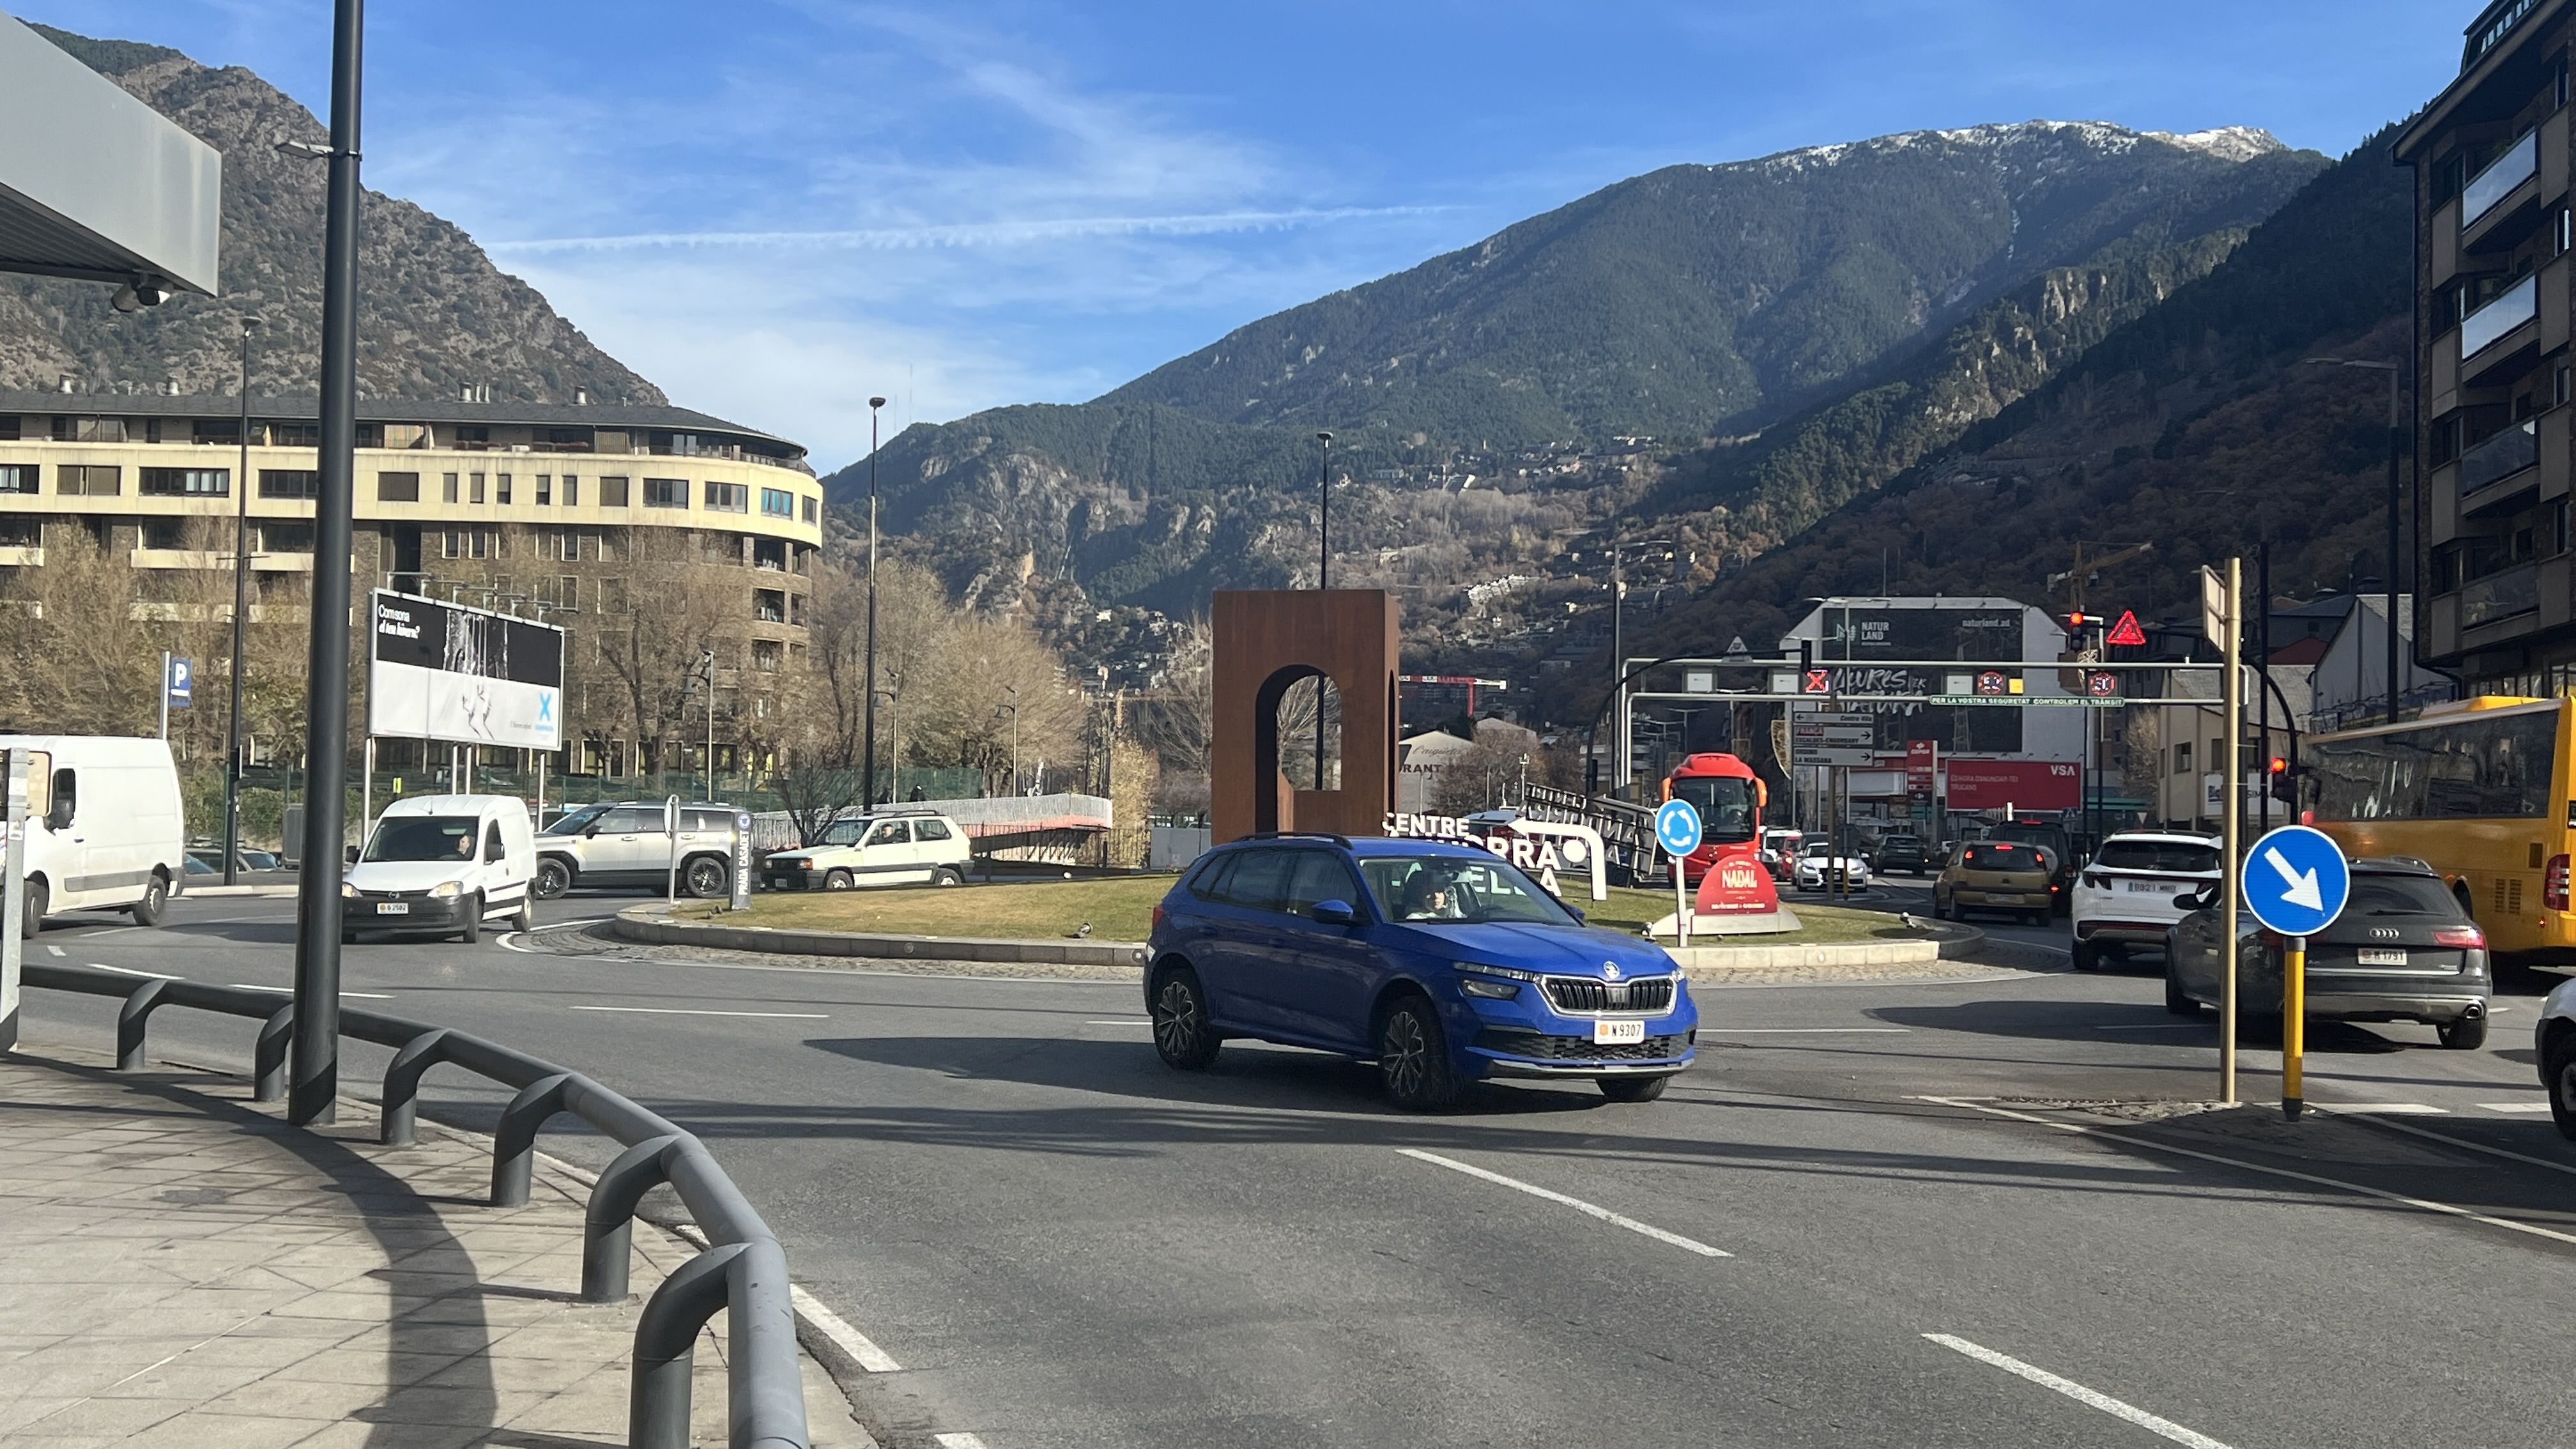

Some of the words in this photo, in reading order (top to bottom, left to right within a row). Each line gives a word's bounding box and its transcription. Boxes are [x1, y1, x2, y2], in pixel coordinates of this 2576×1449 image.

[1861, 622, 1889, 631] NATUR
[1861, 631, 1884, 640] LAND
[174, 663, 187, 687] P
[2050, 765, 2076, 776] VSA
[1722, 870, 1758, 888] NADAL
[1620, 1024, 1641, 1037] 9307
